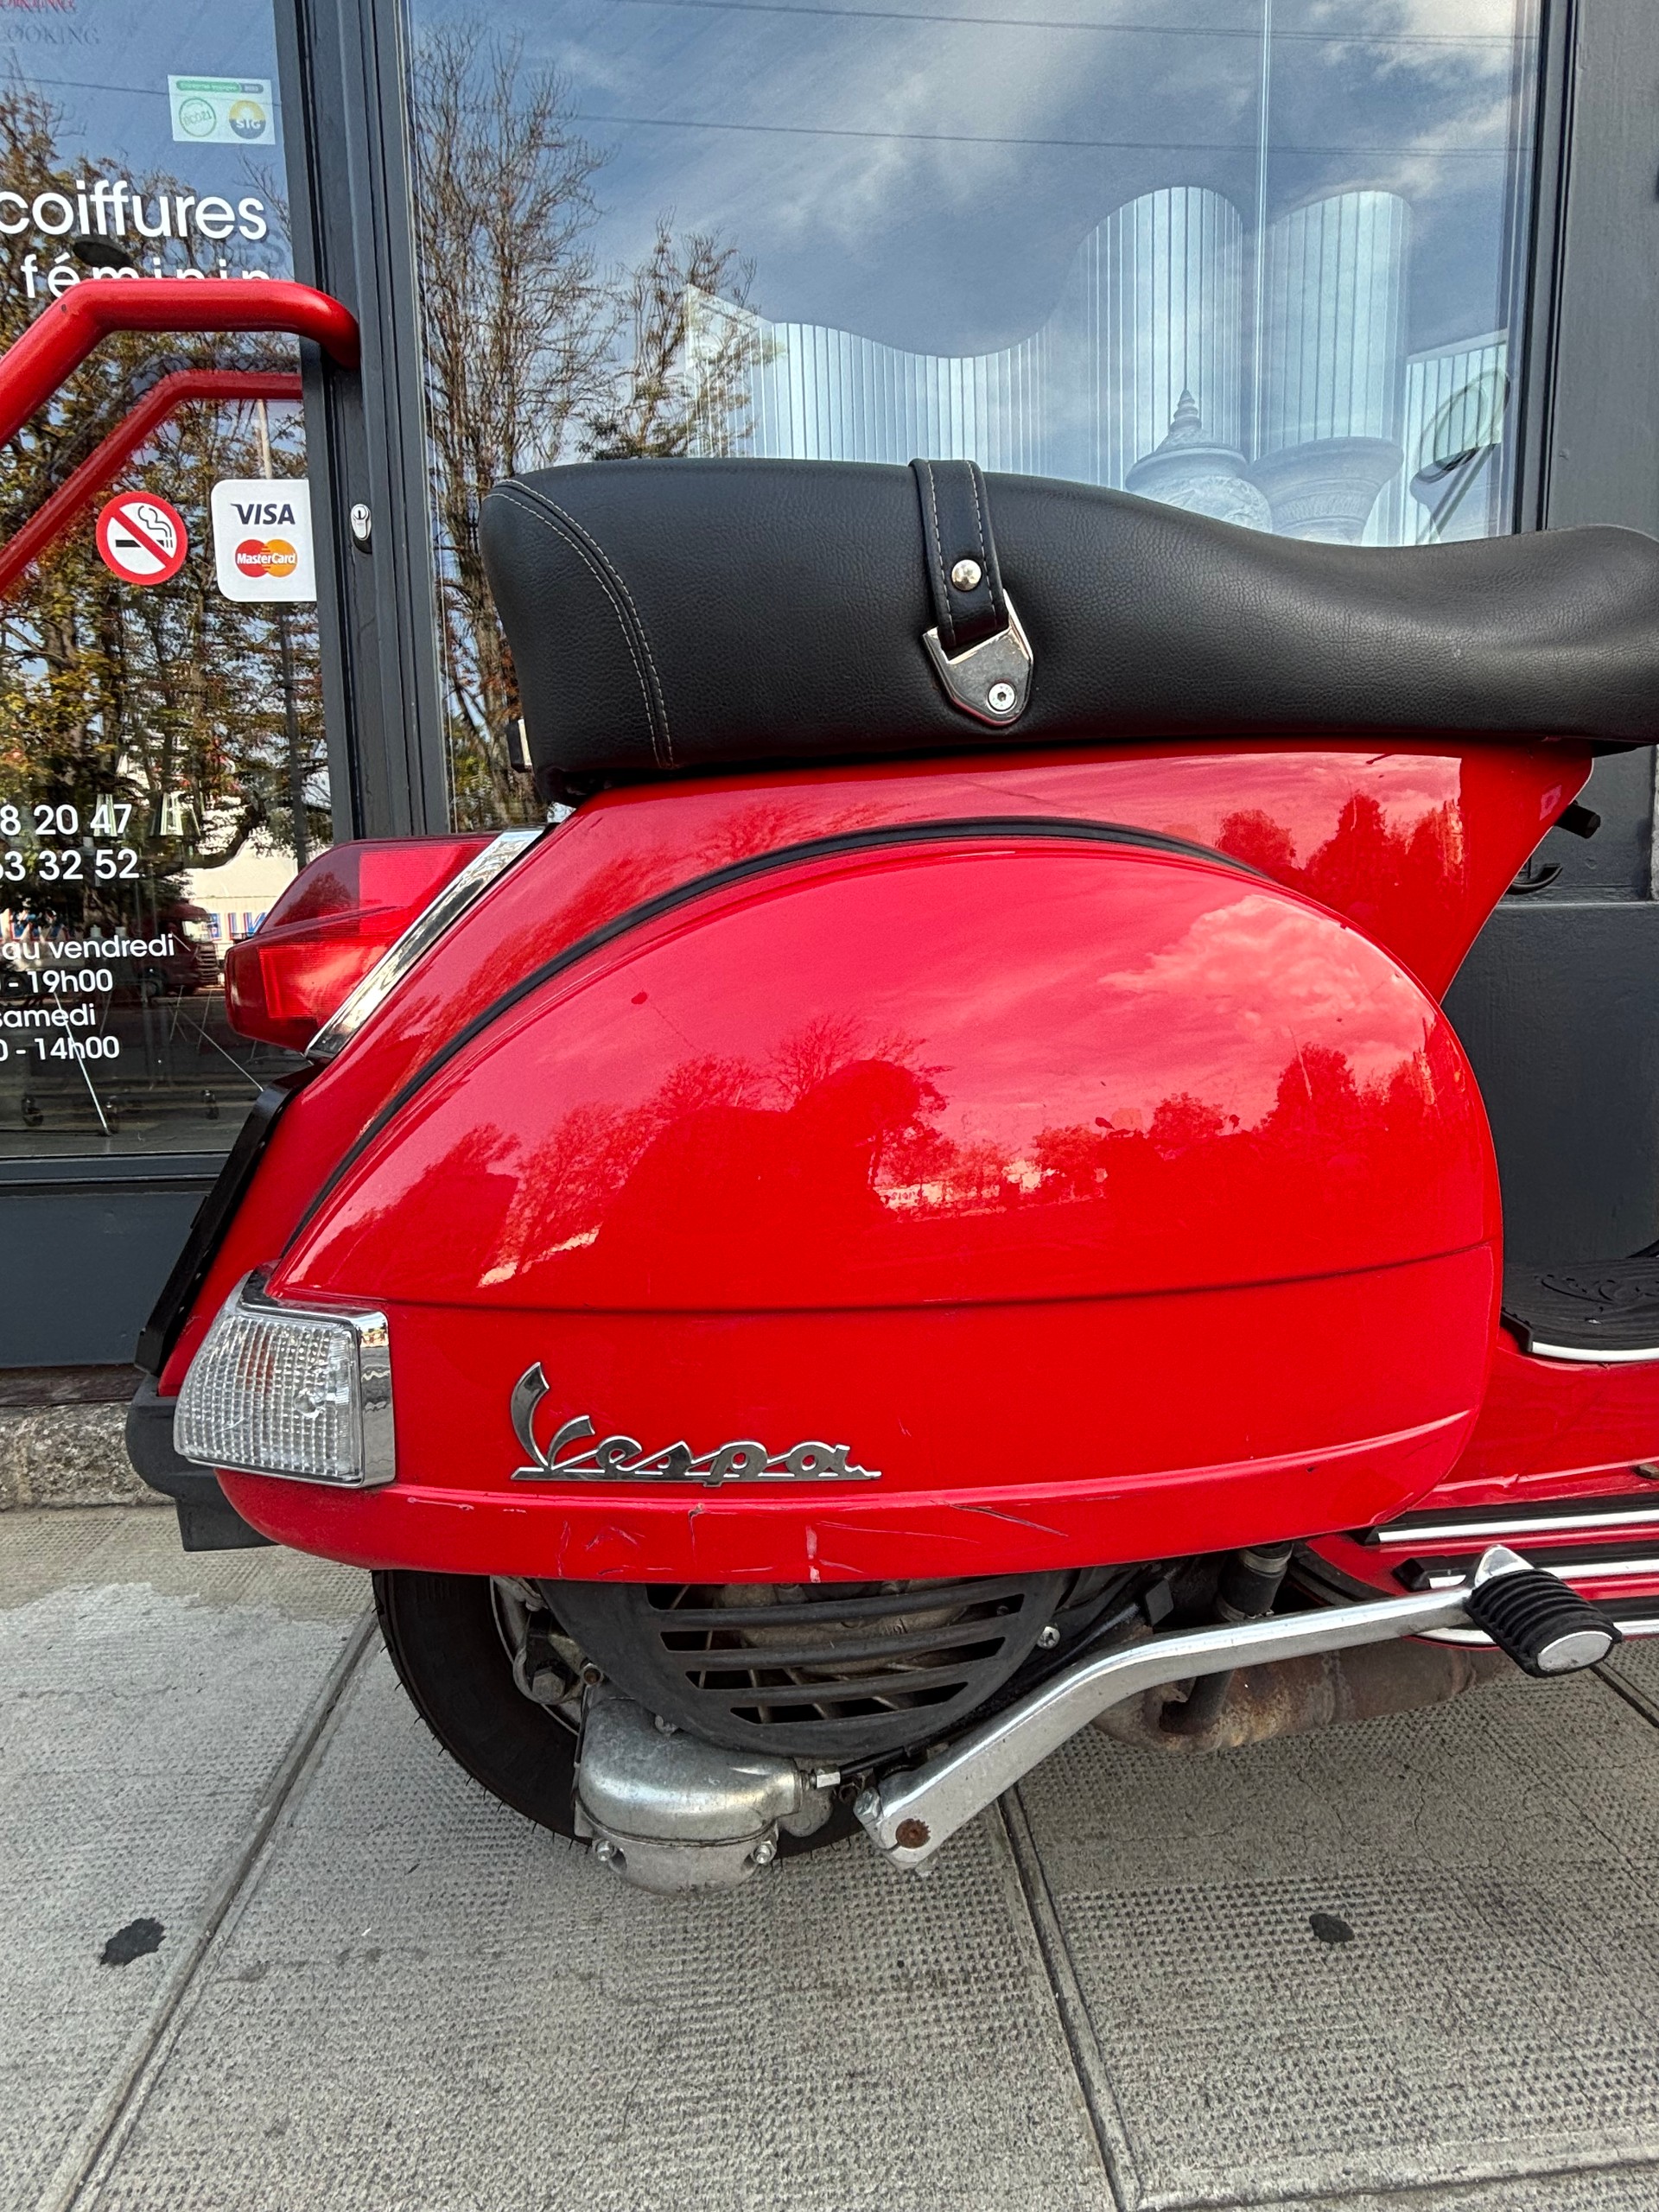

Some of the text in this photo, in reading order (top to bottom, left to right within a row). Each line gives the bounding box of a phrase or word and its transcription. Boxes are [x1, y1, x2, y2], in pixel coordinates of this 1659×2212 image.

[236, 119, 262, 130] SIG
[0, 180, 267, 240] coiffures
[231, 503, 296, 525] VISA
[236, 552, 296, 565] MasterCard
[0, 804, 132, 836] 8 20 47
[0, 849, 140, 881] 3 32 52
[2, 933, 175, 961] au vendredi
[27, 969, 113, 993] 19h00
[0, 1003, 96, 1028] amedi
[35, 1036, 120, 1060] 14h00
[511, 1361, 881, 1487] Vespa
